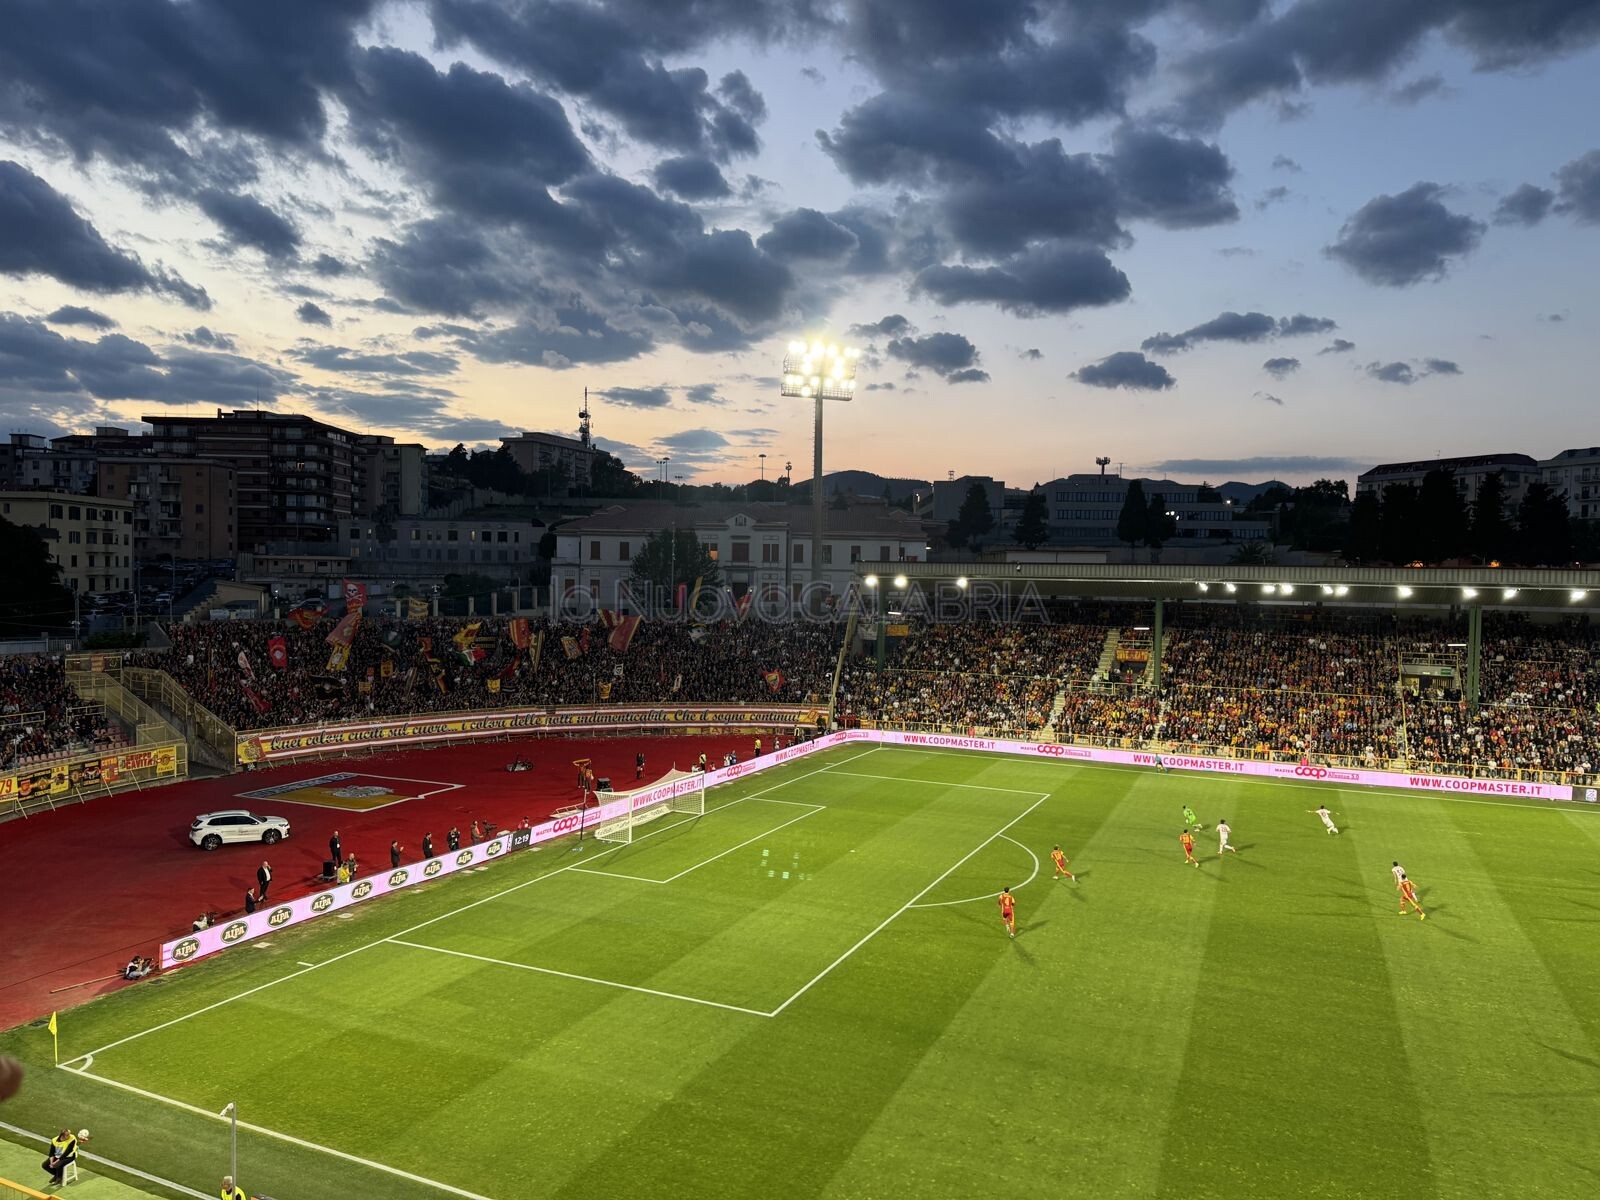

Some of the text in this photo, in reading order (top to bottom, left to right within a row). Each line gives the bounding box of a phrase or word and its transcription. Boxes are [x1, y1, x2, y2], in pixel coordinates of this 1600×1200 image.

[305, 731, 344, 746] colori
[348, 726, 384, 741] cuciti
[388, 723, 409, 737] sul
[470, 716, 506, 730] colori
[510, 713, 542, 727] delle
[545, 713, 573, 727] notti
[674, 709, 698, 722] Che
[700, 709, 709, 721] il
[712, 711, 745, 724] sogno
[749, 710, 801, 722] continui!
[903, 734, 995, 750] WWW.COOPMASTER.IT
[125, 752, 152, 762] GRUPPO
[1037, 745, 1064, 756] coop
[1295, 766, 1327, 779] coop
[1409, 777, 1543, 796] WWW.COOPMASTER.IT
[553, 815, 578, 833] coop
[514, 833, 530, 846] 12:19
[487, 844, 501, 854] ALPA
[457, 853, 472, 864] ALPA
[425, 863, 442, 875] ALPA
[390, 874, 407, 885] ALPA
[353, 884, 370, 897] ALPA
[313, 898, 331, 910] ALPA
[270, 911, 290, 924] ALPA
[224, 926, 245, 940] ALPA
[175, 943, 198, 958] ALPA
